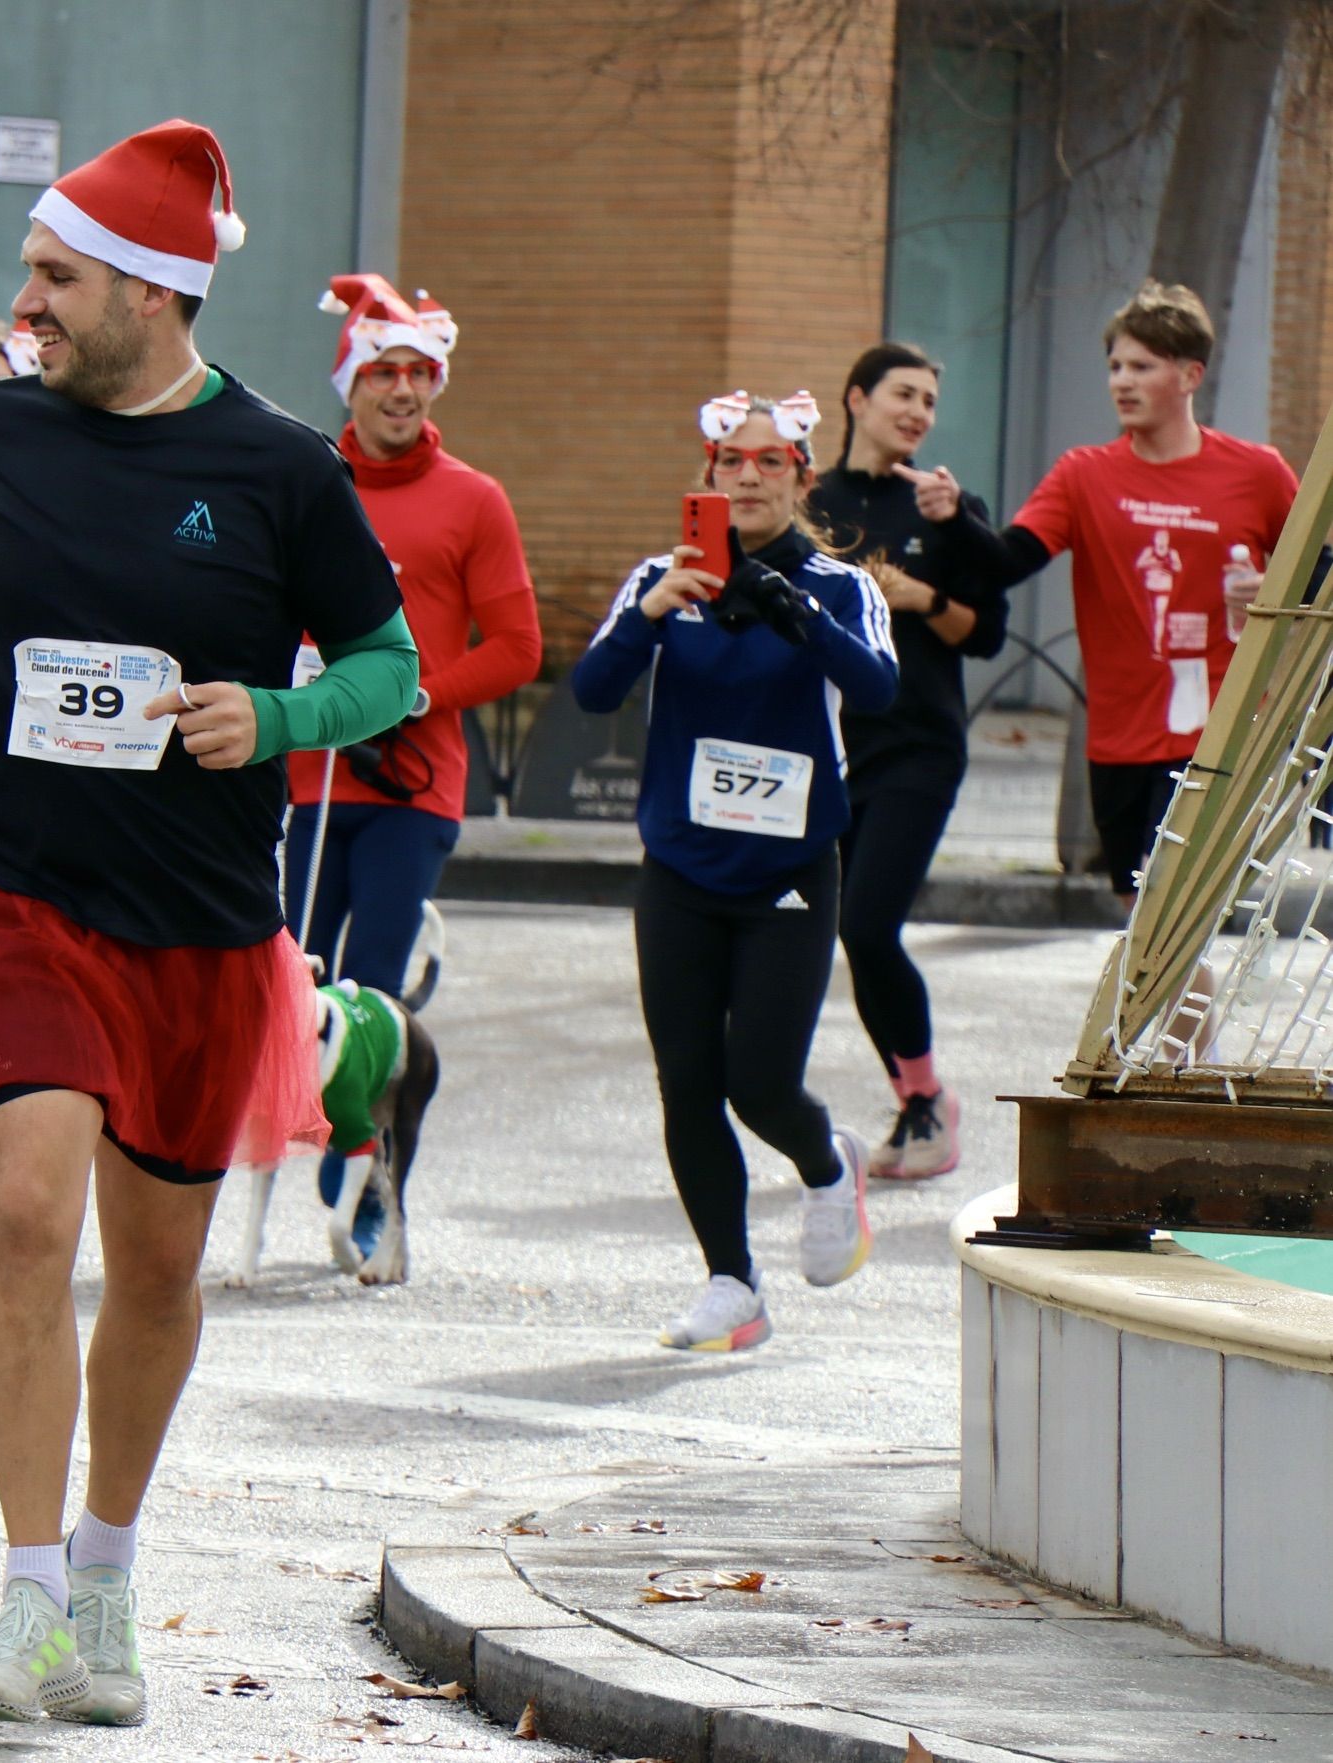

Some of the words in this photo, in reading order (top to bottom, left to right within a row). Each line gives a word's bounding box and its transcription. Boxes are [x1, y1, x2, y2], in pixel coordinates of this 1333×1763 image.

[174, 526, 217, 543] ACTIVA
[33, 652, 48, 662] San
[50, 652, 90, 666] Silvestre
[31, 662, 60, 674] Ciudad
[62, 666, 74, 675] de
[76, 666, 110, 678] Lucena
[58, 682, 125, 719] 39
[53, 736, 76, 749] vtv
[114, 742, 159, 752] enerplus
[712, 769, 784, 798] 577
